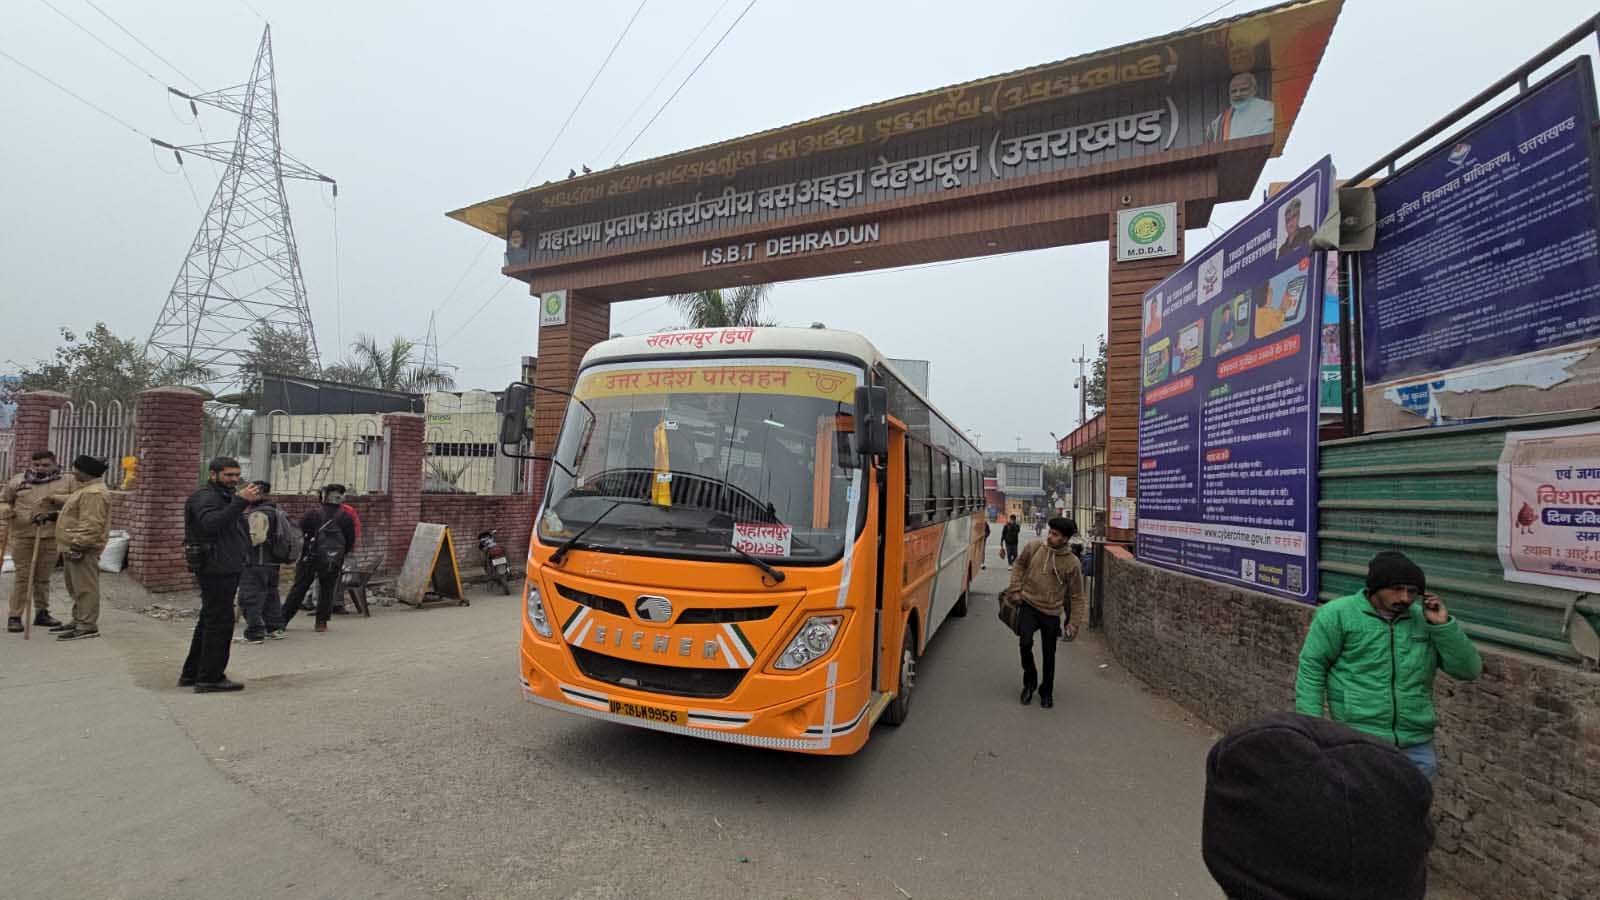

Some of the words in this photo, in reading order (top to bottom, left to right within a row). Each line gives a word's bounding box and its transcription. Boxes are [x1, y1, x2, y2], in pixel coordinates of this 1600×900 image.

[1422, 177, 1460, 206] शिकायत
[1517, 115, 1576, 155] उत्तराखण्ड
[538, 221, 601, 251] महाराणा
[605, 211, 650, 244] प्रताप
[758, 182, 796, 209] बस
[870, 146, 980, 189] देहरादून
[766, 223, 880, 257] DEHRADUN
[1246, 228, 1272, 251] NOTHING
[1241, 238, 1277, 268] EVERYTHING
[645, 330, 713, 349] सहारनपुर
[606, 371, 640, 390] उत्तर
[646, 367, 696, 388] प्रदेश
[703, 367, 792, 388] परिवहन
[1555, 465, 1572, 480] एवं
[1547, 510, 1571, 524] दिन
[1576, 530, 1600, 542] सम
[595, 625, 718, 661] EICHER
